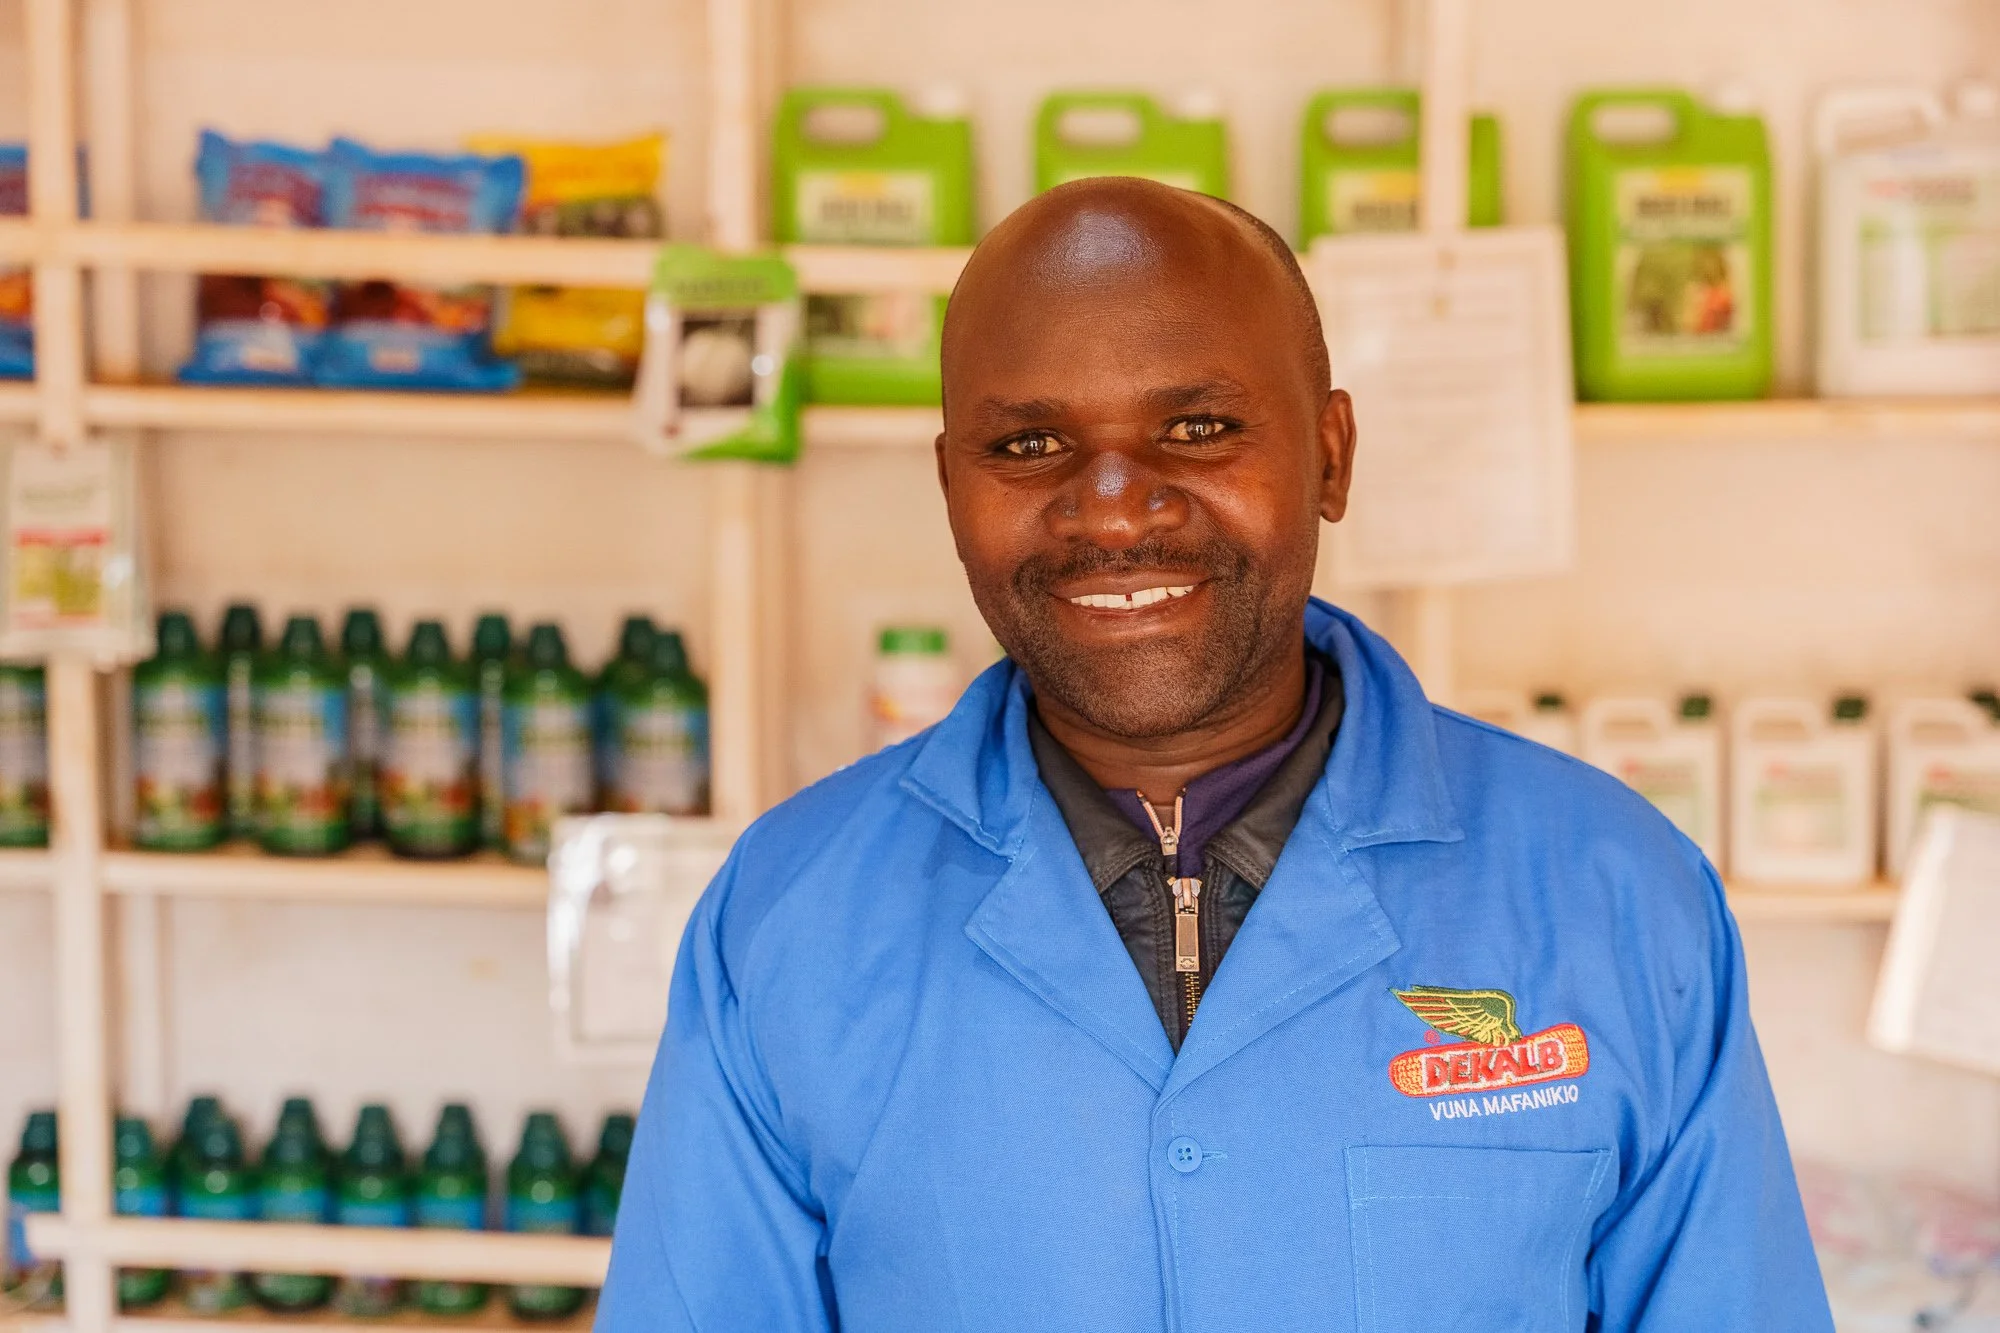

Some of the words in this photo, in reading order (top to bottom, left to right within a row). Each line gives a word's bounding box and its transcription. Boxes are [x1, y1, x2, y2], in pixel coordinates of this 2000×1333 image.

[1425, 1040, 1564, 1088] DEKALB
[1429, 1098, 1482, 1121] VUNA
[1482, 1084, 1579, 1116] MAFANIKIO
